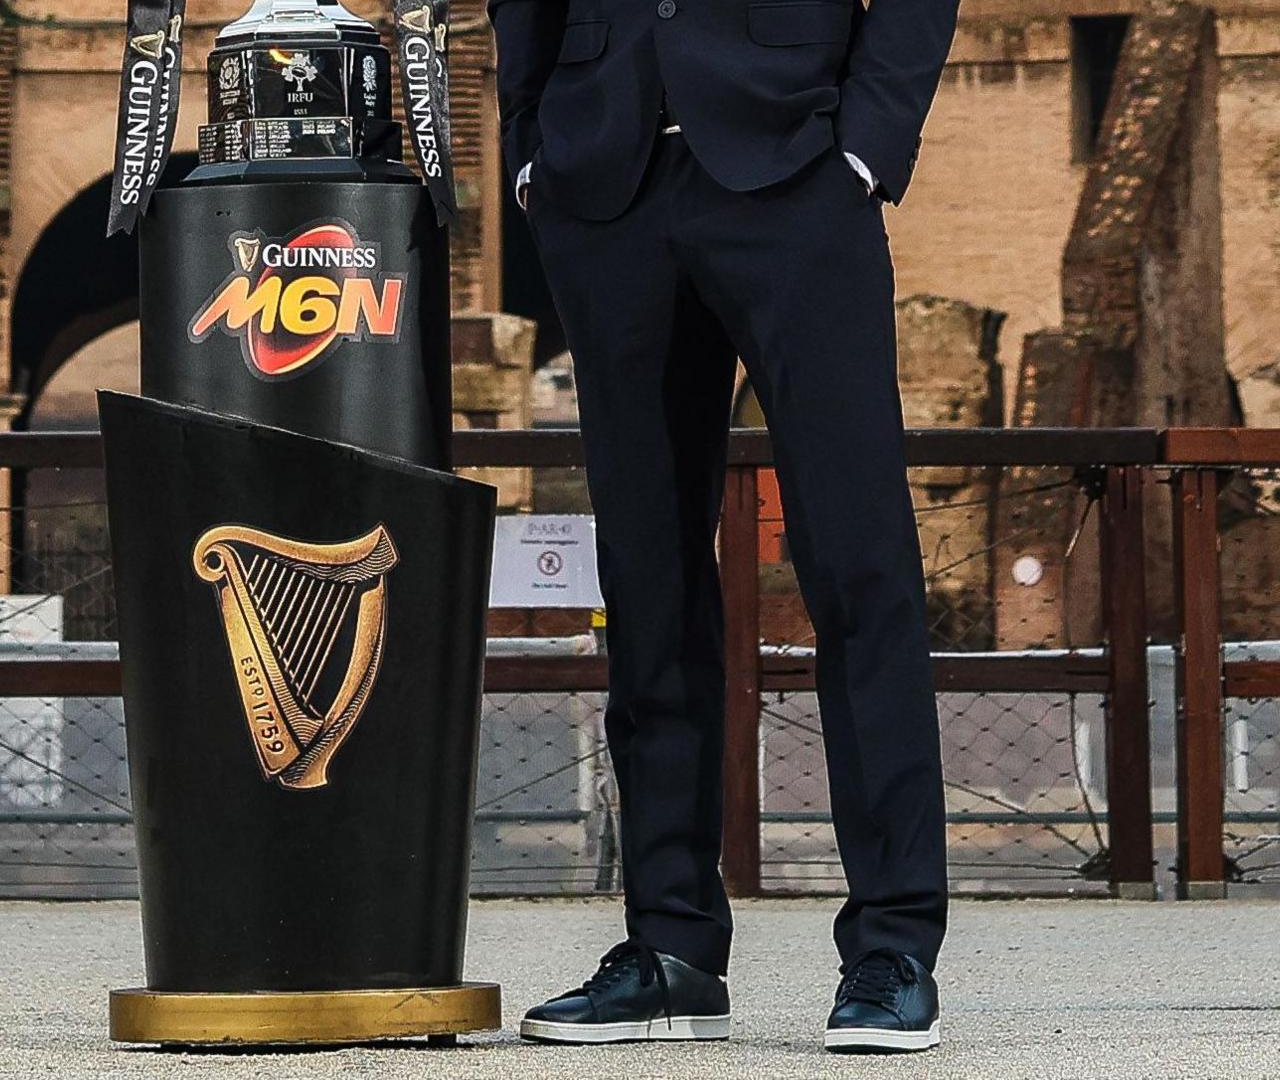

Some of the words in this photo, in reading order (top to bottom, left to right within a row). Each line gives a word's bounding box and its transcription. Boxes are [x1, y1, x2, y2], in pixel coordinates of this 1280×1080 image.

[287, 92, 314, 103] IRFU
[405, 36, 442, 178] GUINNESS
[120, 60, 159, 206] GUINNESS
[262, 243, 376, 268] GUINNESS
[192, 276, 403, 335] M6N
[252, 701, 285, 753] 1759
